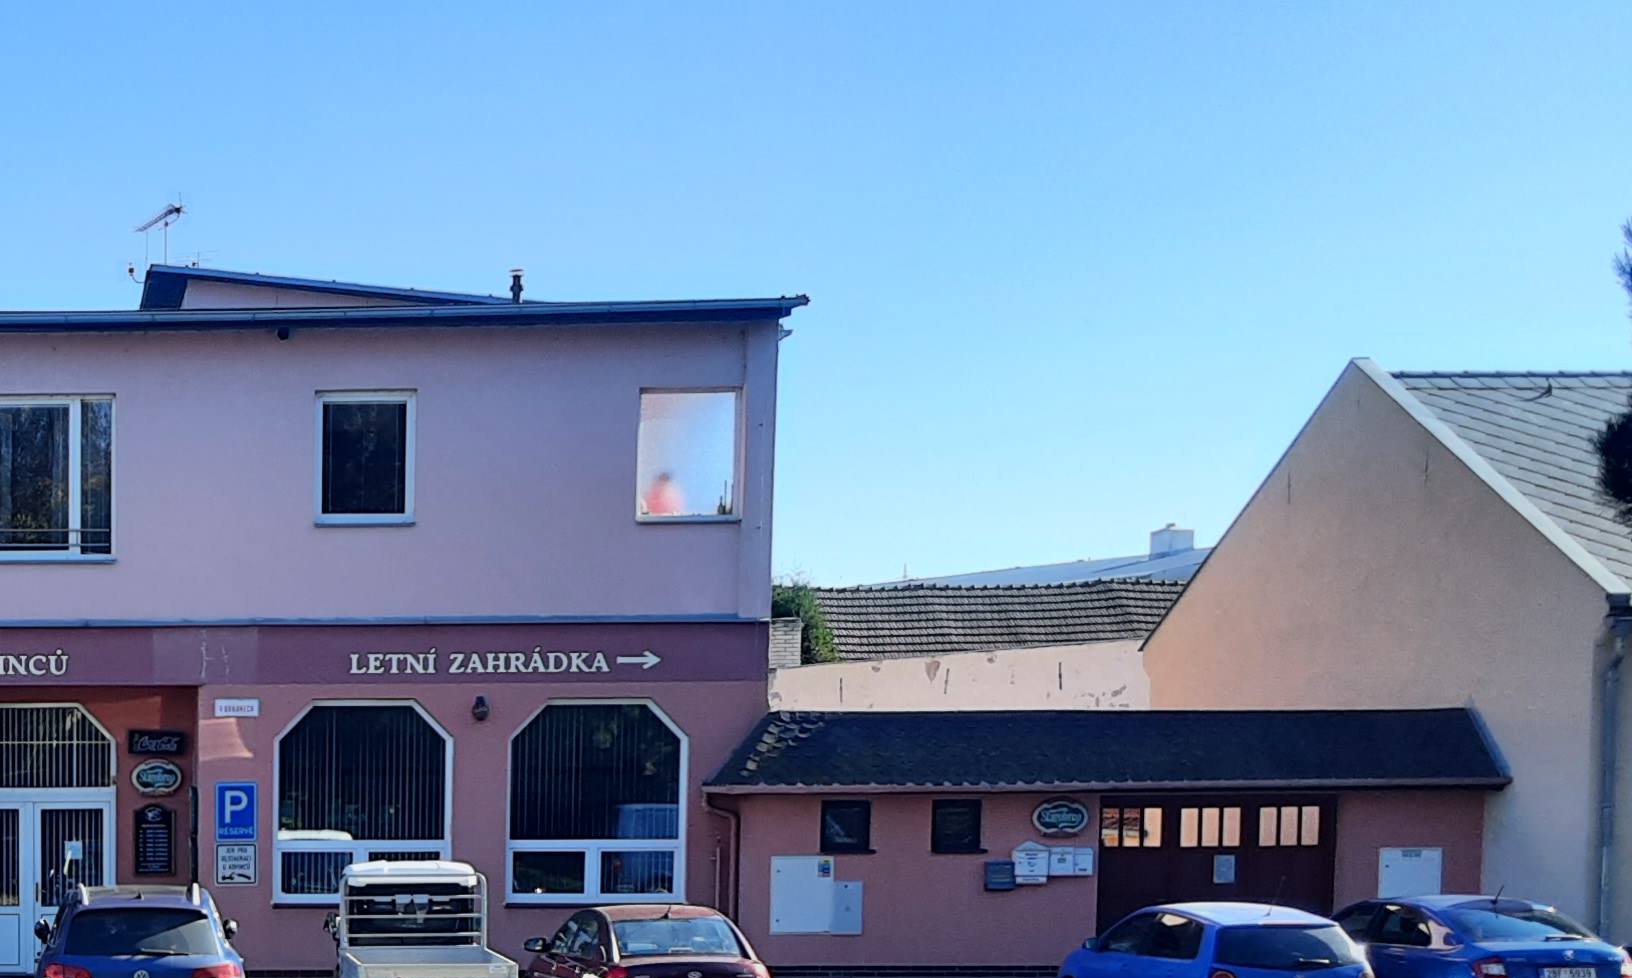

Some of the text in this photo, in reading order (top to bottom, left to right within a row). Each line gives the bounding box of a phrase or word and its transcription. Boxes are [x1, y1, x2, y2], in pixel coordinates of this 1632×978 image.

[349, 646, 610, 674] LETNÍ ZAHRÁDKA
[224, 789, 249, 824] P
